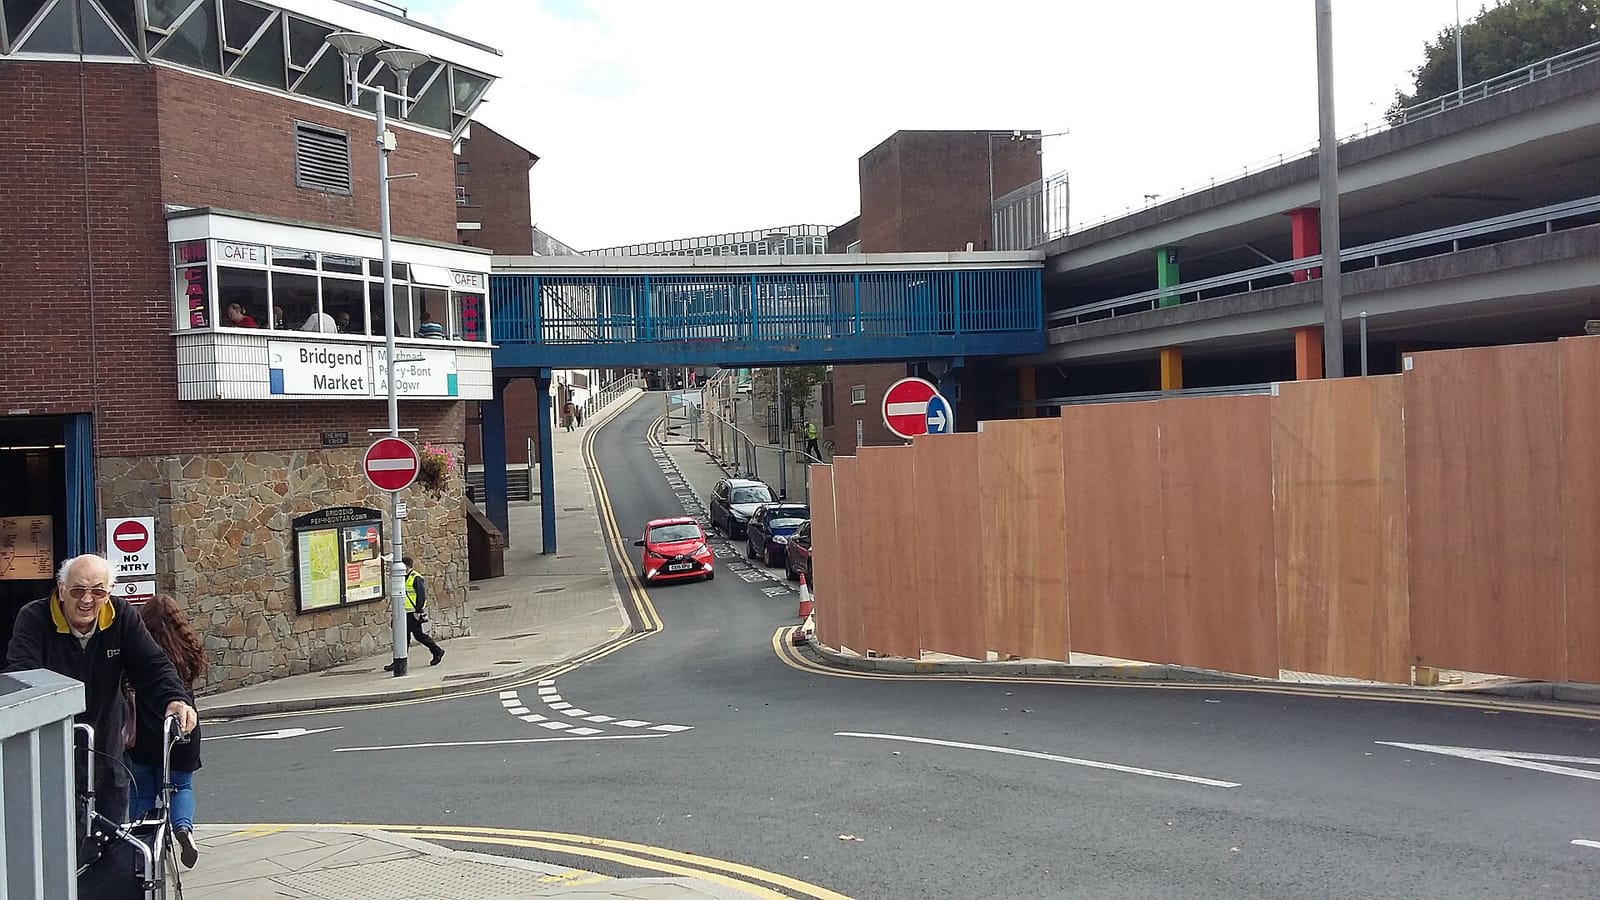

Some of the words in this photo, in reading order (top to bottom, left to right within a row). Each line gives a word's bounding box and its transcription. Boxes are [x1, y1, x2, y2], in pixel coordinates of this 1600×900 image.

[224, 245, 257, 261] CAFE
[454, 273, 477, 286] CAFE
[299, 348, 363, 369] Bridgend
[378, 350, 424, 362] Mchnad
[379, 364, 432, 379] Pe-y-Bont
[313, 375, 365, 391] Market
[395, 379, 420, 393] Ogwr
[123, 554, 139, 563] NO
